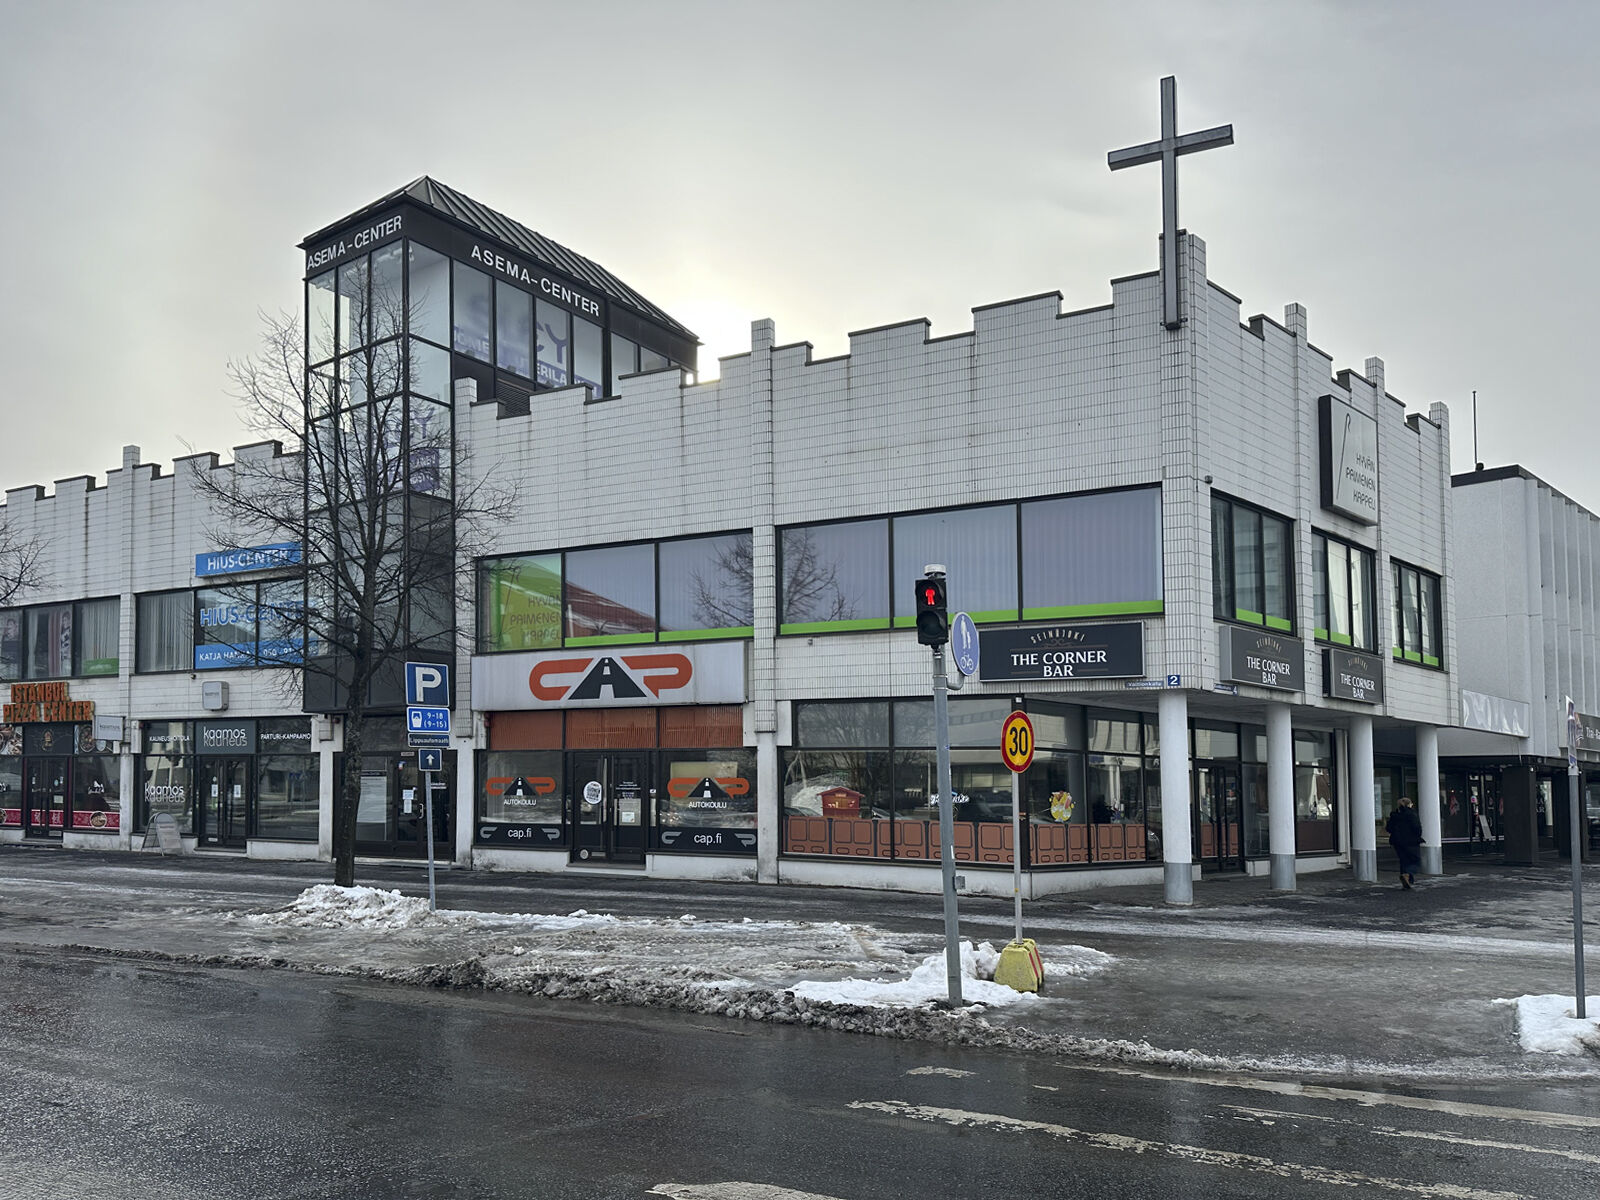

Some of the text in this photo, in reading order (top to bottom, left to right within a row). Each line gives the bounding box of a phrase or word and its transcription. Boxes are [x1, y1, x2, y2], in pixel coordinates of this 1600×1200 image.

[307, 215, 402, 270] ASEMA-CENTER
[471, 245, 600, 317] ASEMA-CENTER
[200, 652, 222, 661] KATJA
[1011, 650, 1107, 666] THE CORNER
[1043, 664, 1074, 677] BAR
[1246, 656, 1290, 676] THE CORNER
[529, 653, 692, 701] CAP
[1170, 675, 1178, 685] 2
[1262, 672, 1277, 686] BAR
[1340, 673, 1376, 692] THE CORNER
[415, 666, 442, 703] P
[11, 682, 68, 703] ISTANBUL
[1352, 687, 1365, 699] BAR
[3, 701, 91, 722] PIZZA CENTER
[426, 711, 444, 720] 9-18
[203, 726, 246, 739] kaamos
[1009, 726, 1028, 757] 30
[144, 782, 184, 796] kaamos
[688, 801, 727, 809] AUTOKOULU
[507, 828, 532, 840] cap.fi
[693, 833, 722, 846] cap.fi
